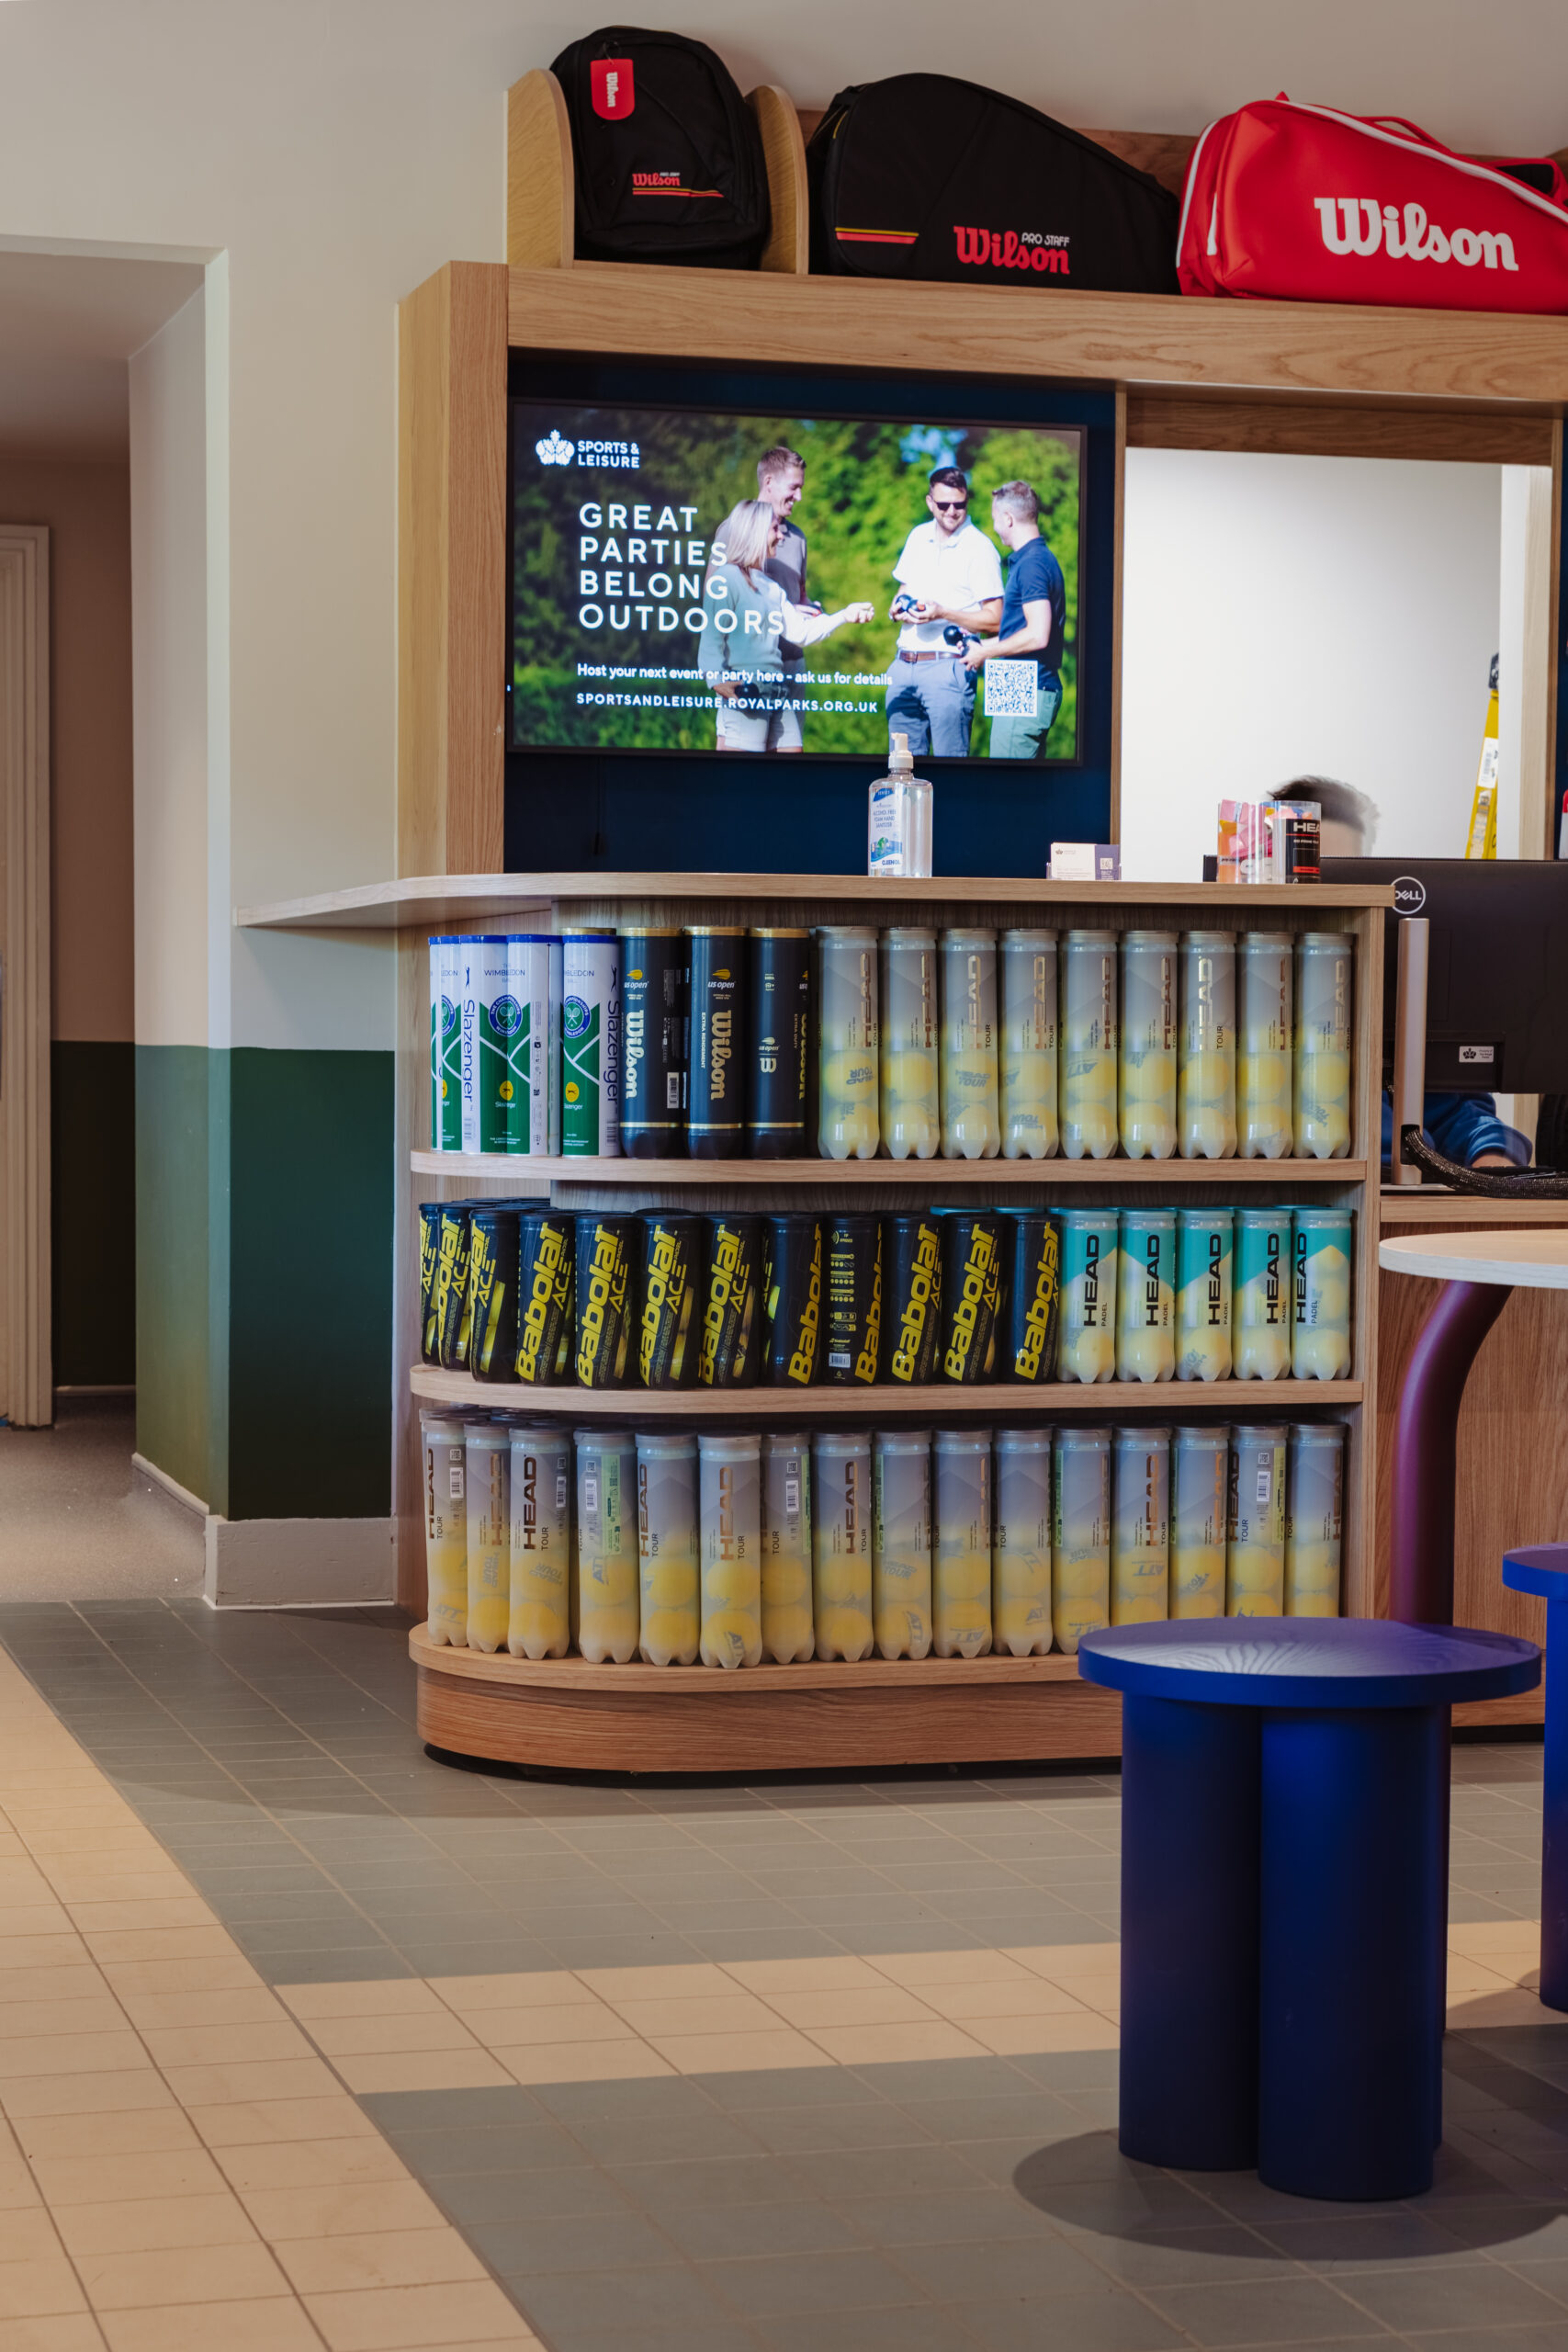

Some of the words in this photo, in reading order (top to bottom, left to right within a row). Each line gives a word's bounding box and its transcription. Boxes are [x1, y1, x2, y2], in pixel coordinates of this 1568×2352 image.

[605, 72, 619, 108] Wilson
[632, 172, 681, 187] Wilson
[953, 225, 1071, 275] Wilson
[1021, 232, 1043, 244] PRO
[1043, 234, 1069, 247] STAFF
[1314, 197, 1519, 272] Wilson
[577, 441, 628, 454] SPORTS
[630, 443, 640, 456] &
[577, 454, 640, 469] LEISURE
[579, 503, 698, 533] GREAT
[580, 536, 728, 567] PARTIES
[579, 603, 784, 636] OUTDOORS
[580, 570, 728, 601] BELONG
[577, 663, 607, 676] Host
[609, 667, 637, 680] your
[639, 667, 667, 679] next
[669, 667, 704, 680] event
[705, 670, 720, 680] or
[722, 669, 753, 684] party
[757, 669, 784, 683] here
[795, 671, 816, 684] ask
[818, 673, 832, 684] us
[834, 672, 852, 684] for
[853, 673, 893, 685] details
[577, 693, 878, 713] SPORTSANDLEISURE.ROYALPARKS.ORG.UK
[1395, 889, 1422, 900] DELL
[716, 981, 735, 990] open
[860, 952, 872, 1047] HEAD
[967, 956, 982, 1049] HEAD
[1033, 956, 1047, 1049] HEAD
[463, 999, 476, 1102] Slazenger
[604, 1000, 620, 1102] Slazenger
[626, 1010, 645, 1100] Wilson
[711, 1010, 732, 1101] Wilson
[422, 1248, 437, 1295] ACE
[450, 1250, 471, 1299] ACE
[478, 1259, 496, 1308] ACE
[517, 1222, 566, 1382] Babolat
[551, 1261, 572, 1312] ACE
[577, 1224, 621, 1387] Babolat
[608, 1262, 628, 1315] ACE
[639, 1224, 678, 1387] Babolat
[665, 1264, 687, 1316] ACE
[701, 1224, 742, 1385] Babolat
[729, 1264, 750, 1316] ACE
[892, 1224, 939, 1382] Babolat
[943, 1224, 996, 1382] Babolat
[983, 1261, 999, 1312] ACE
[1014, 1222, 1058, 1381] Babolat
[1083, 1234, 1100, 1327] HEAD
[1145, 1234, 1160, 1327] HEAD
[1208, 1233, 1222, 1326] HEAD
[1266, 1233, 1279, 1325] HEAD
[1296, 1231, 1307, 1323] HEAD
[1310, 1299, 1318, 1324] PADEL
[427, 1448, 435, 1539] HEAD
[524, 1457, 537, 1550] HEAD
[639, 1463, 649, 1557] HEAD
[720, 1466, 735, 1561] HEAD
[845, 1461, 858, 1555] HEAD
[1145, 1453, 1158, 1547] HEAD
